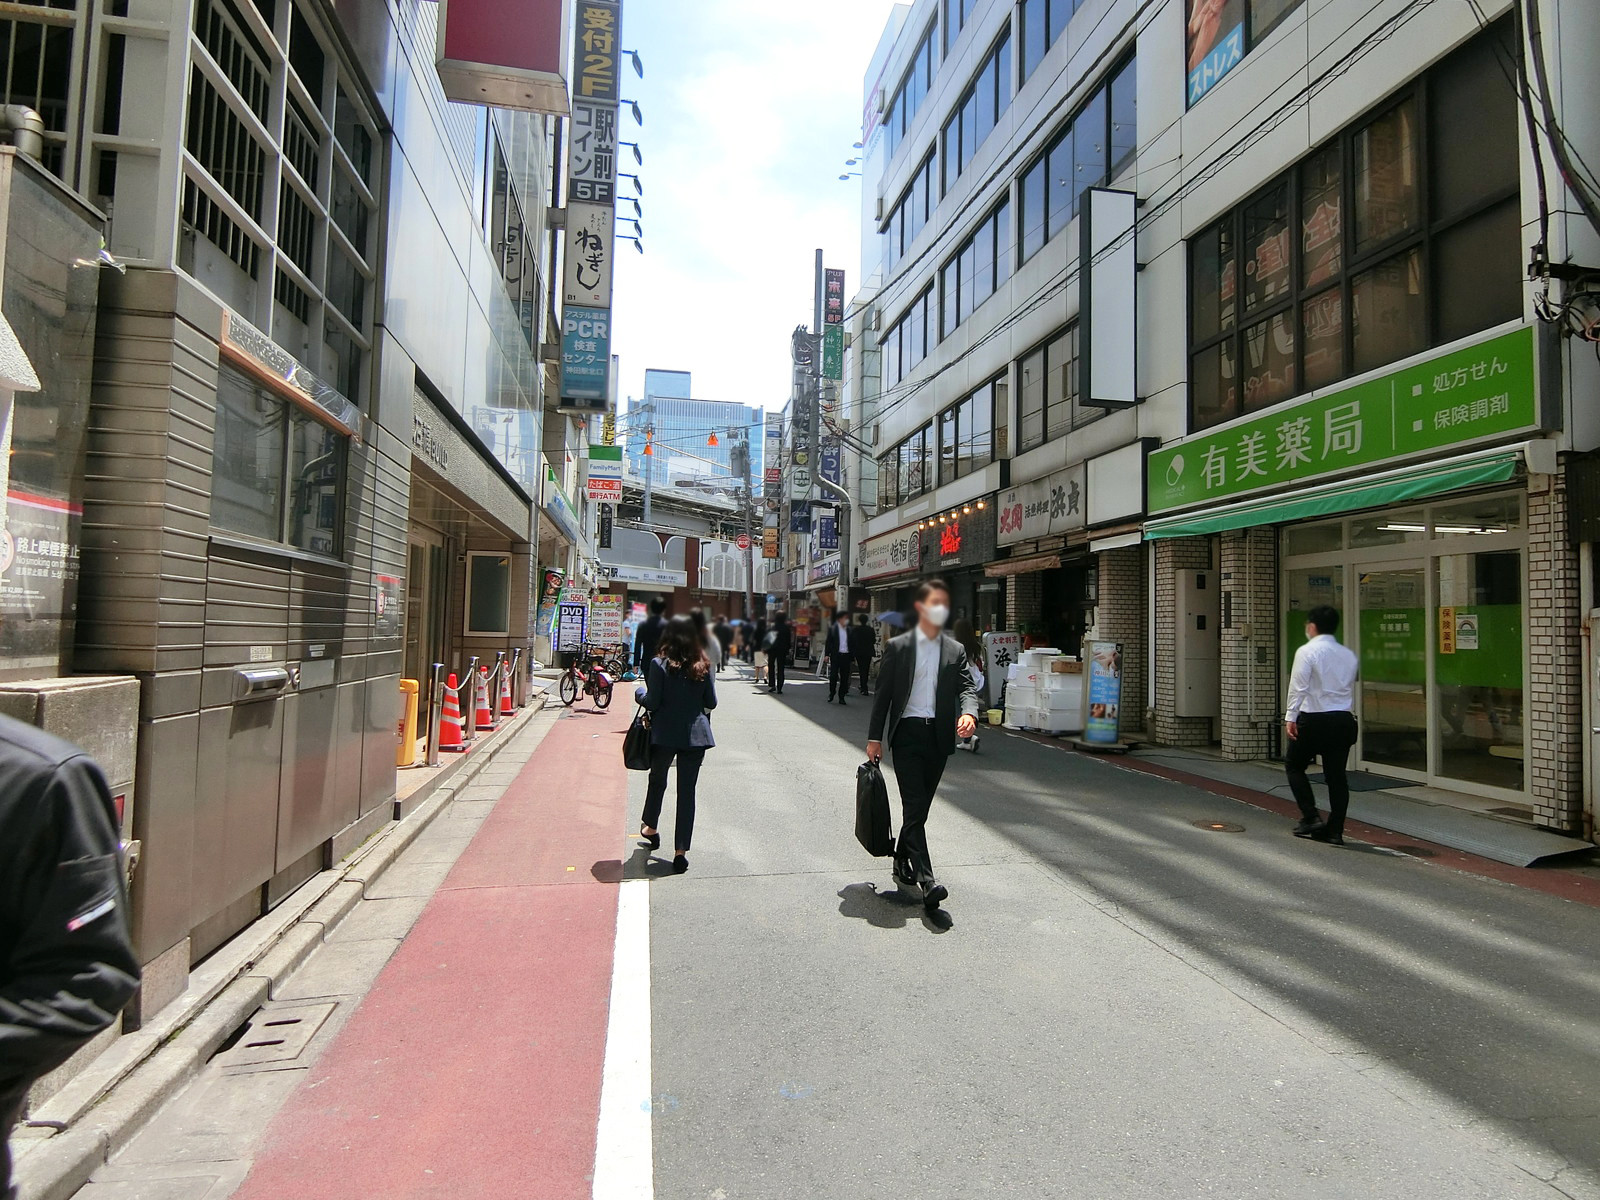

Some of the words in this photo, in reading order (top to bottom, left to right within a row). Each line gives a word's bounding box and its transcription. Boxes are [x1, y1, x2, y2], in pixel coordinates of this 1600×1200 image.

[582, 7, 615, 96] 受付2F
[1190, 32, 1241, 103] ストレス
[574, 106, 593, 176] コイン
[594, 108, 614, 180] 駅前
[576, 182, 609, 200] 5F
[575, 227, 605, 291] ねぎし
[565, 310, 607, 320] アステル薬局
[563, 320, 607, 339] PCR
[574, 340, 597, 352] 検査
[563, 353, 607, 365] センター
[565, 366, 604, 376] 神田駅北口
[1432, 356, 1508, 394] 処方せん
[1433, 393, 1509, 430] 保険調剤
[1200, 401, 1363, 490] 有美薬局
[589, 464, 620, 472] FamilyMart
[589, 481, 620, 490] たばこ・酒
[589, 492, 620, 500] 銀行ATM
[17, 537, 80, 558] 路上喫煙禁止
[16, 556, 25, 564] No
[26, 557, 50, 568] smoking
[562, 607, 583, 615] DVD
[1442, 608, 1452, 652] 保険薬局
